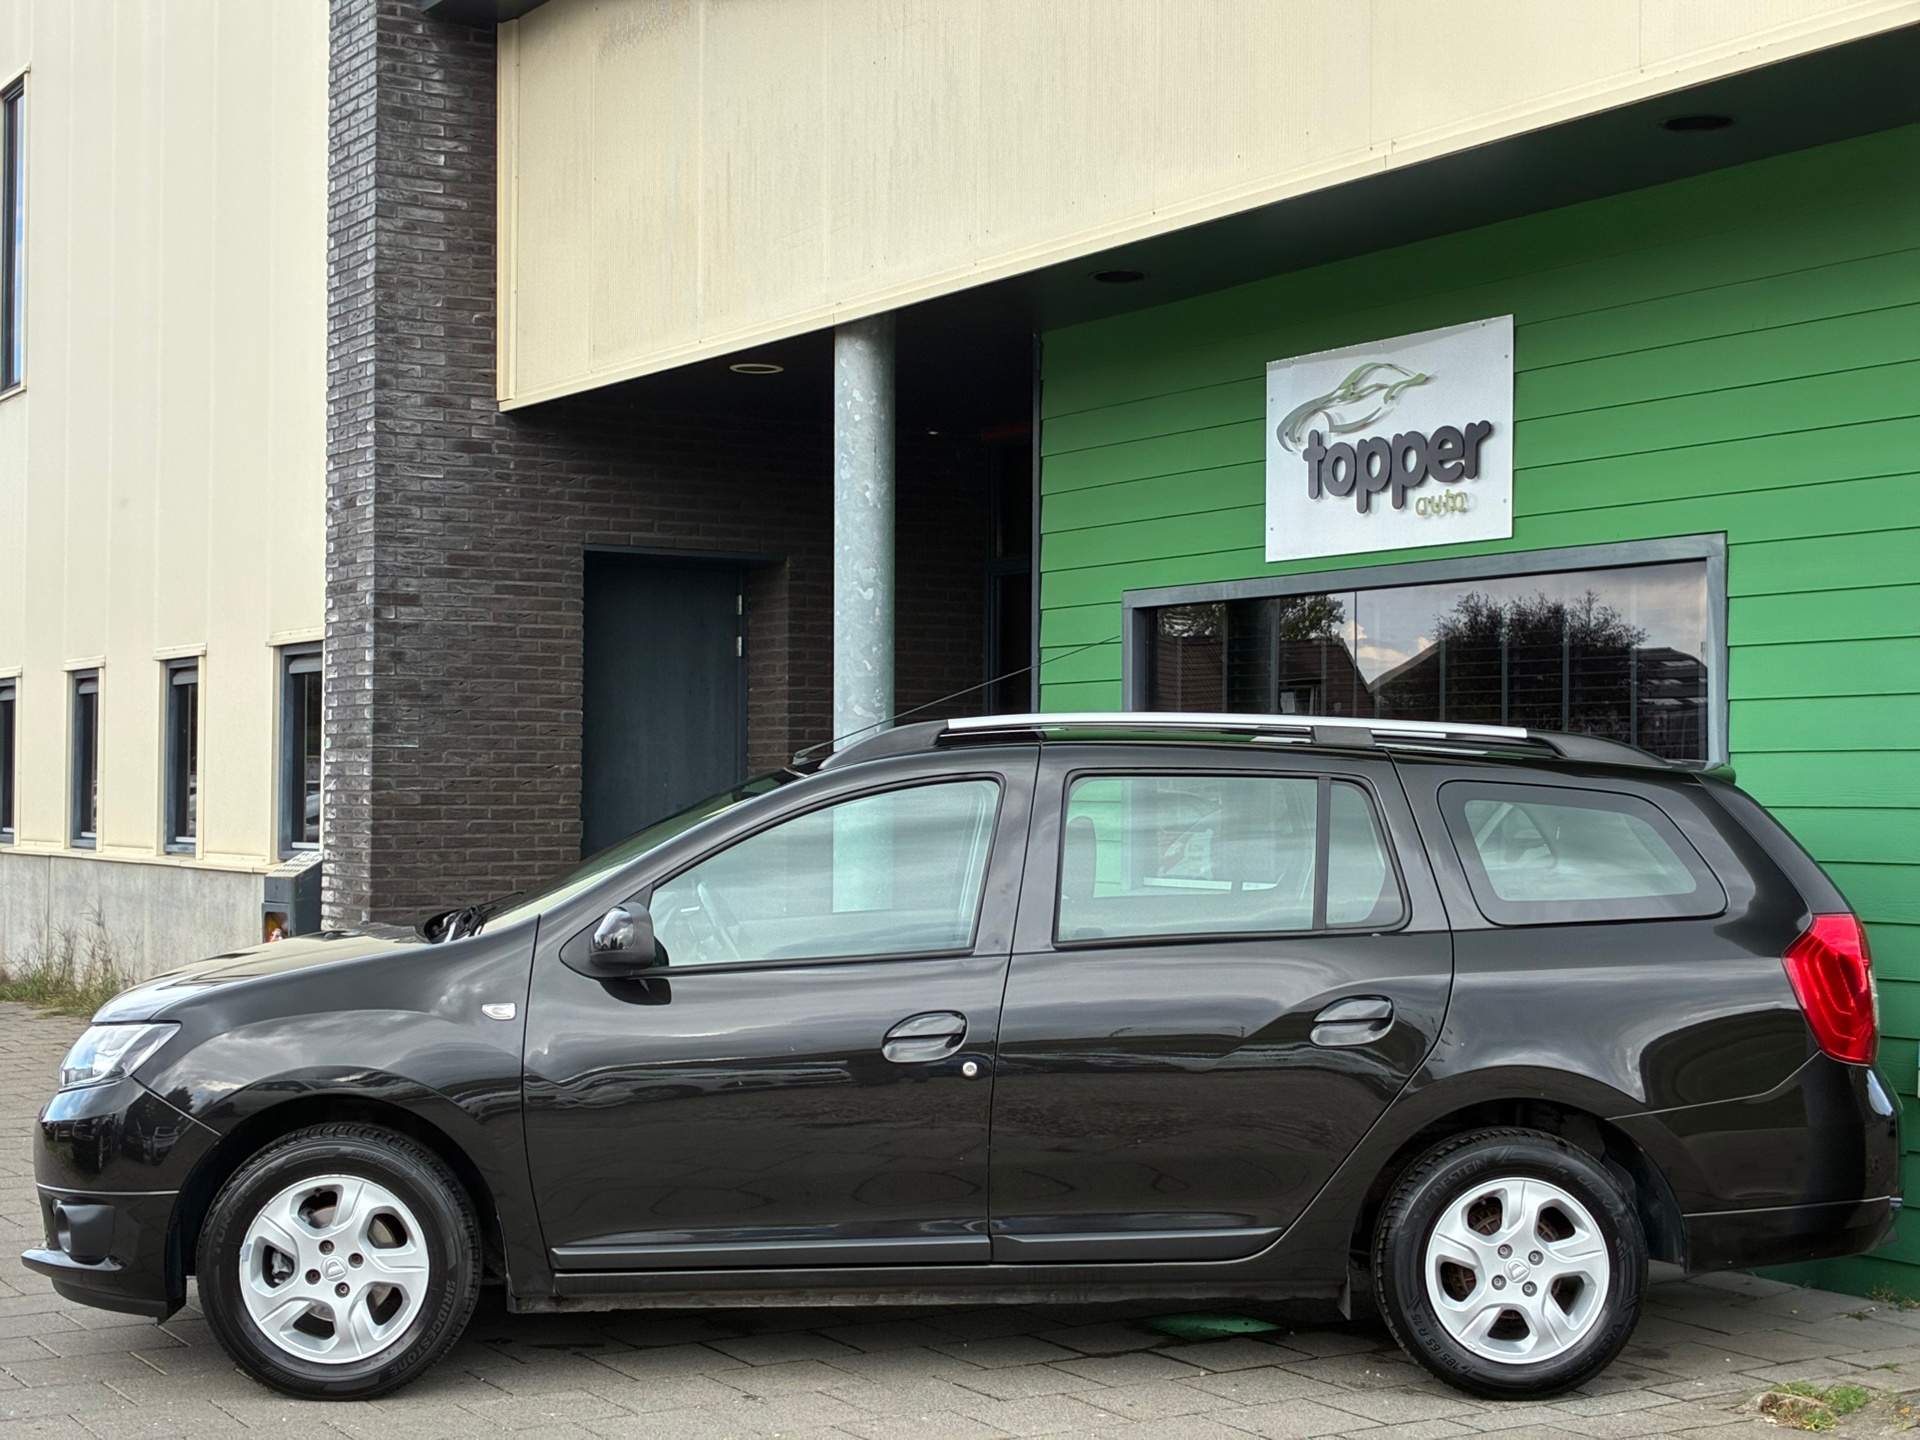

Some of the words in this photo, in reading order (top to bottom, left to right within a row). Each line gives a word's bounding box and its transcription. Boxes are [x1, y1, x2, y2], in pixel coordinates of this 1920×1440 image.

[1303, 420, 1492, 514] topper
[1415, 489, 1468, 516] auto
[388, 1279, 457, 1377] BRIDGESTONE
[1418, 1327, 1430, 1337] R
[1425, 1338, 1460, 1370] 185/65
